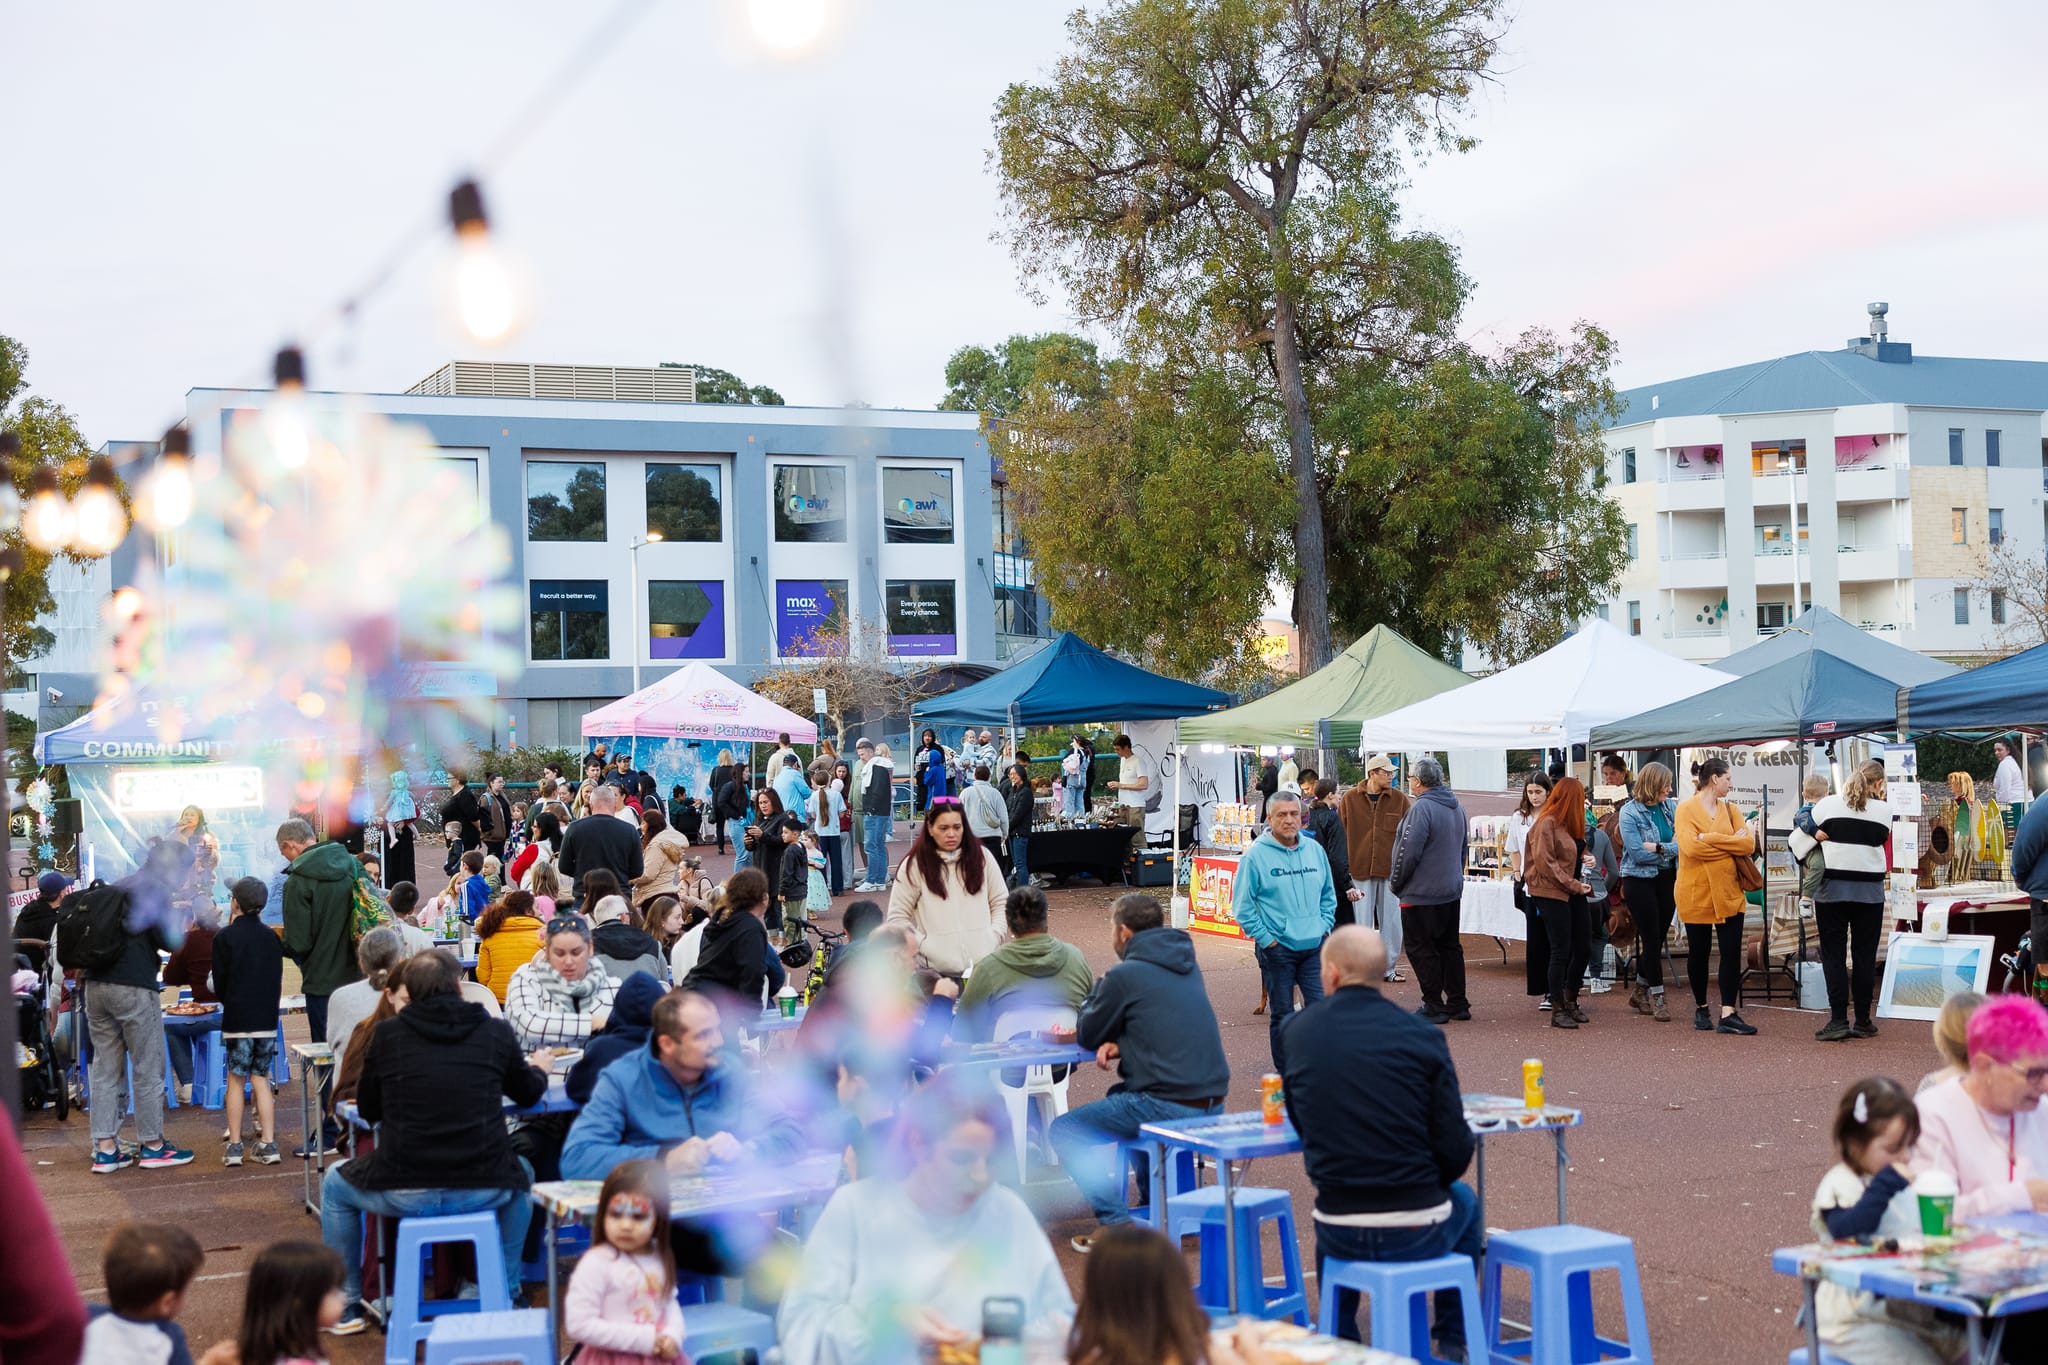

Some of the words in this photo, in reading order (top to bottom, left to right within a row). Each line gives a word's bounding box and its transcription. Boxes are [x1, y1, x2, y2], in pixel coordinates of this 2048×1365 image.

[807, 498, 829, 510] awt
[915, 499, 937, 511] awt
[584, 593, 598, 601] way.
[786, 597, 817, 609] max
[900, 600, 916, 608] Every
[900, 609, 916, 617] Every
[676, 721, 709, 735] Face
[714, 723, 776, 740] Painting
[83, 738, 234, 758] COMMUNIT
[1752, 750, 1809, 767] TREATS
